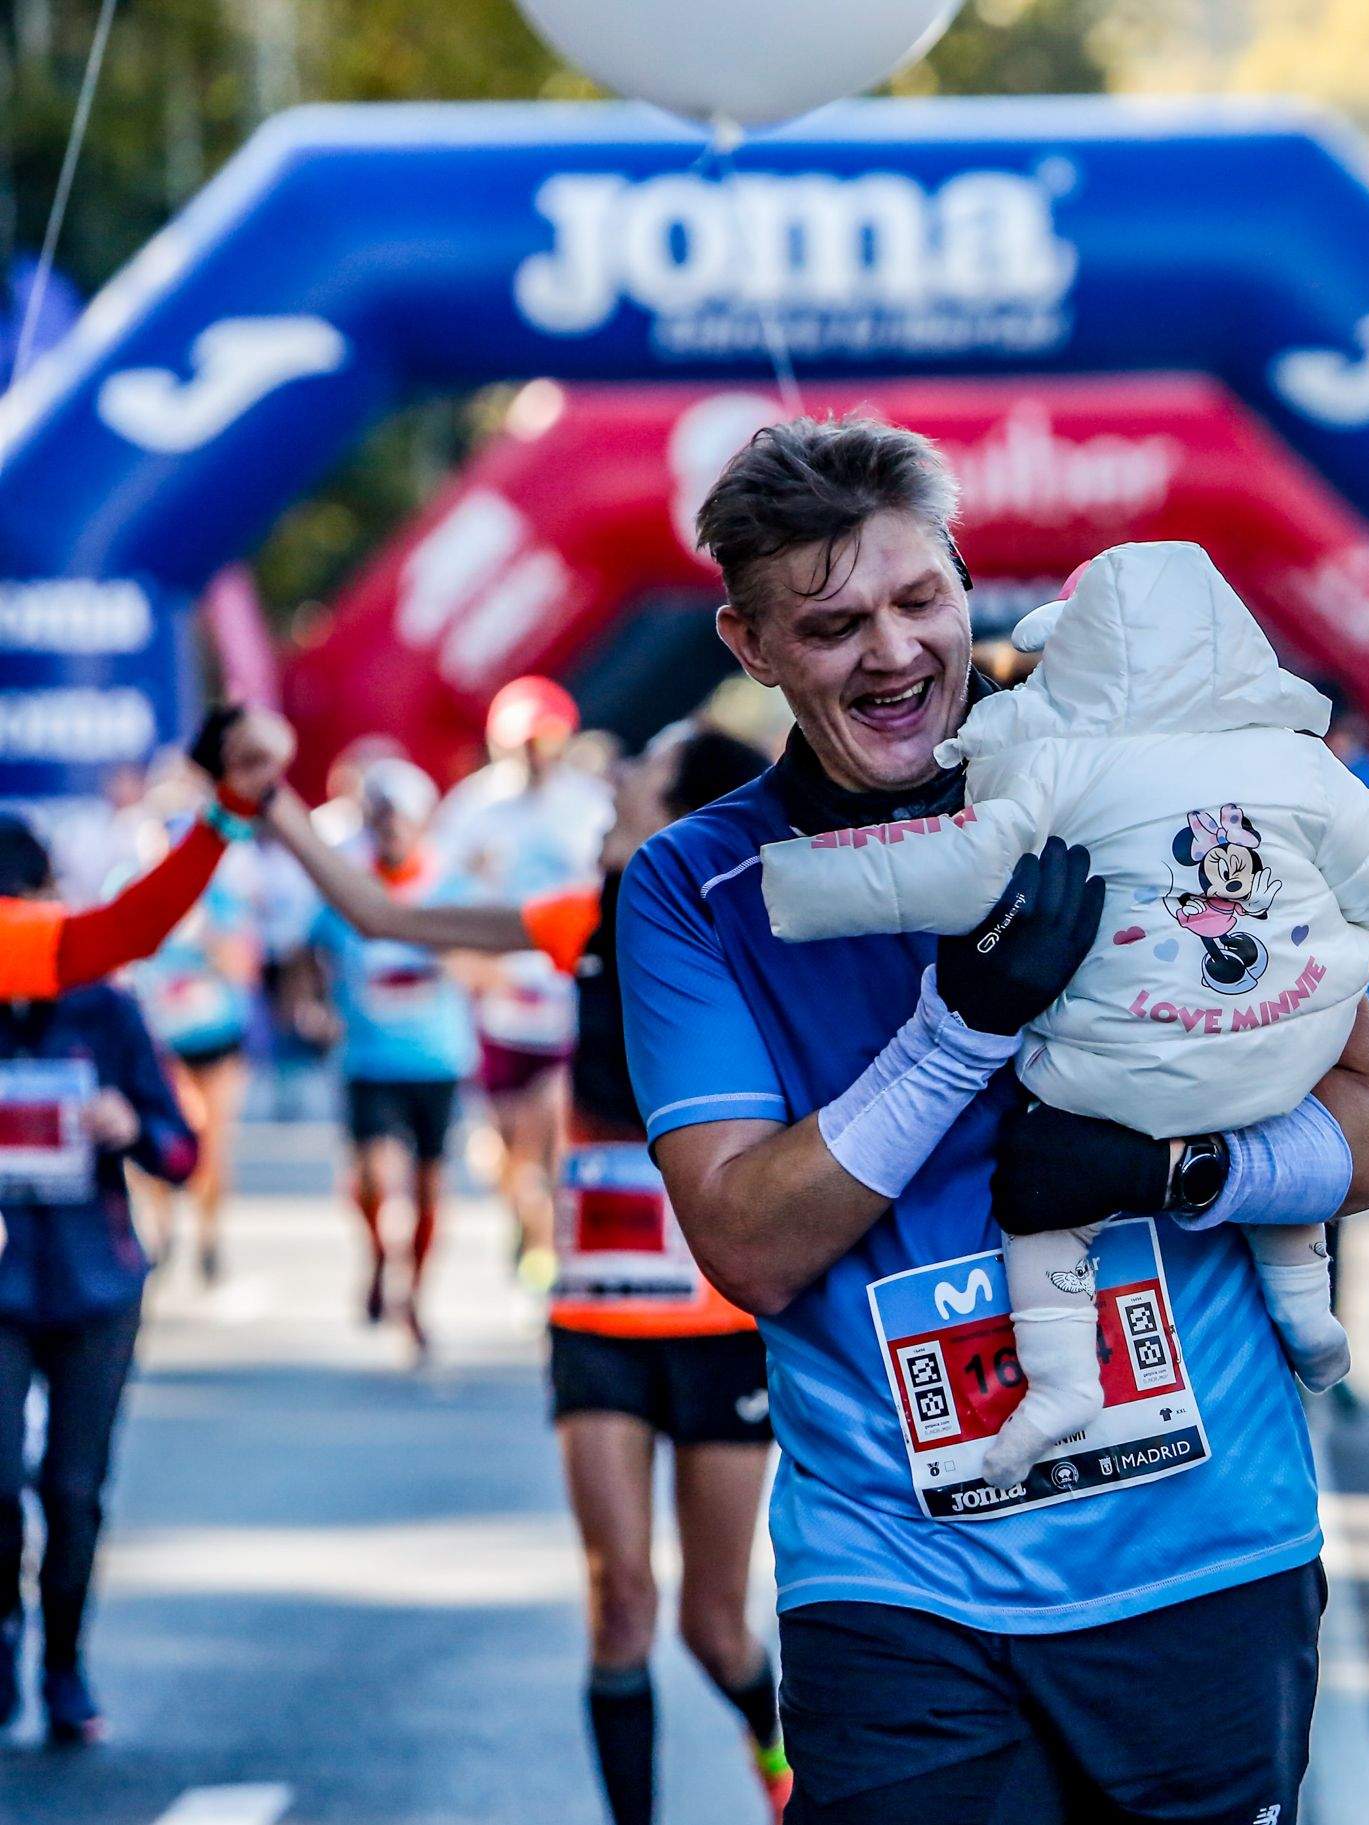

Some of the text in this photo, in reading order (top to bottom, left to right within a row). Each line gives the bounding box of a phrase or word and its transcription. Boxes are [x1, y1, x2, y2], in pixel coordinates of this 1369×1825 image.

[1128, 955, 1328, 1034] LOVE MINNIE
[1121, 1440, 1191, 1469] MADRID
